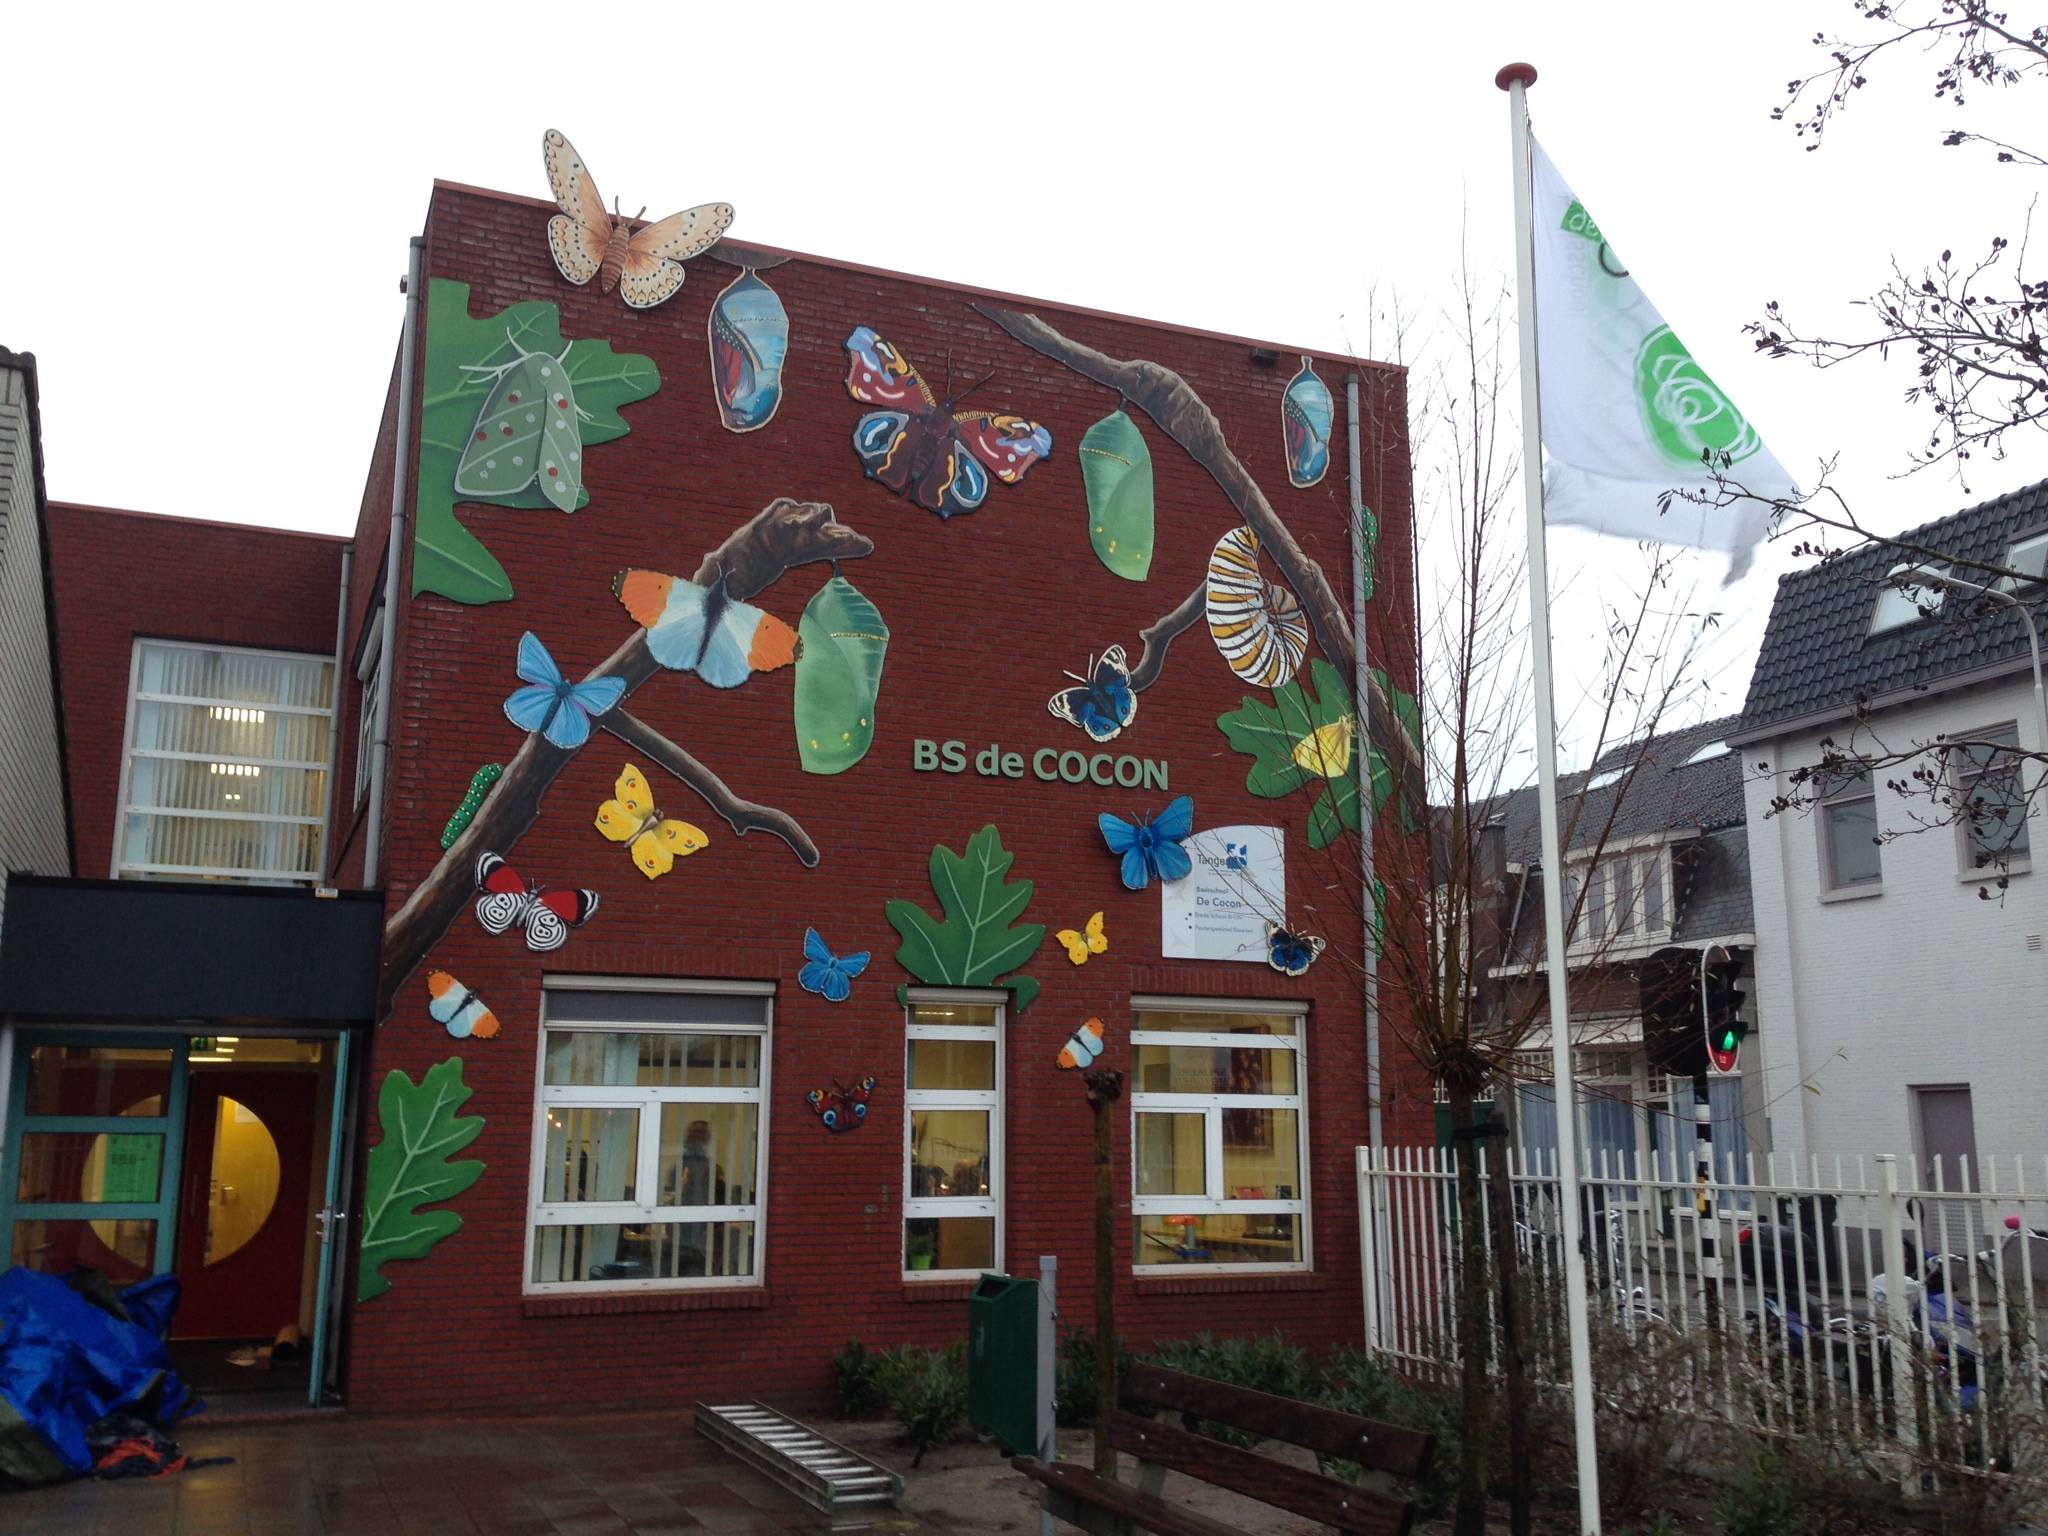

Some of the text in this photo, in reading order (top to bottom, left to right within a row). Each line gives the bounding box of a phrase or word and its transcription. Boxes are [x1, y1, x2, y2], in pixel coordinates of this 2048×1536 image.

[913, 739, 1169, 791] BS de COCON
[1196, 896, 1210, 906] De
